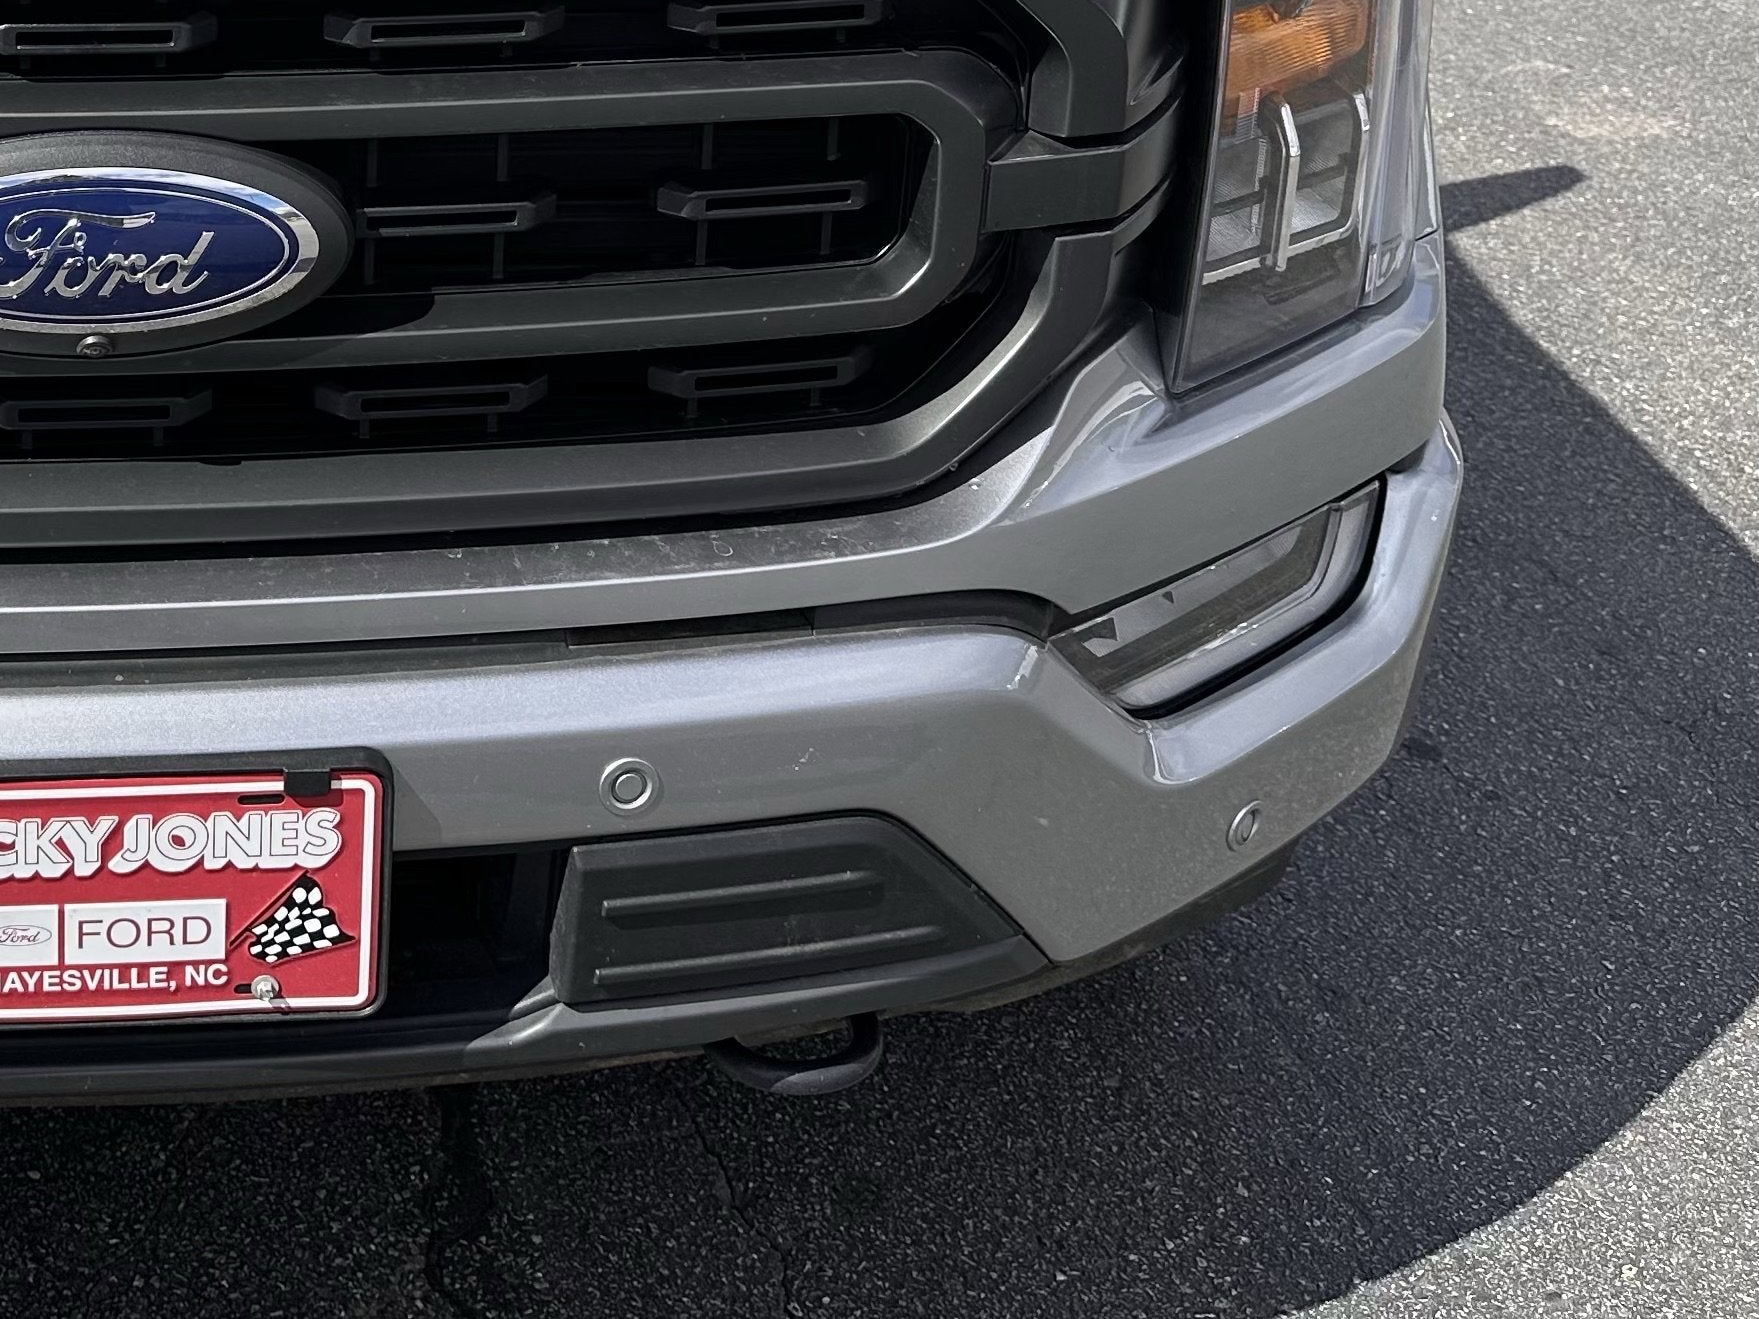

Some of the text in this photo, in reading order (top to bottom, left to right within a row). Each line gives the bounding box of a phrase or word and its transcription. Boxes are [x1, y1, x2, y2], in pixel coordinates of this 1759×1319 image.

[108, 807, 342, 873] JONES
[78, 915, 212, 949] FORD
[184, 963, 229, 987] NC
